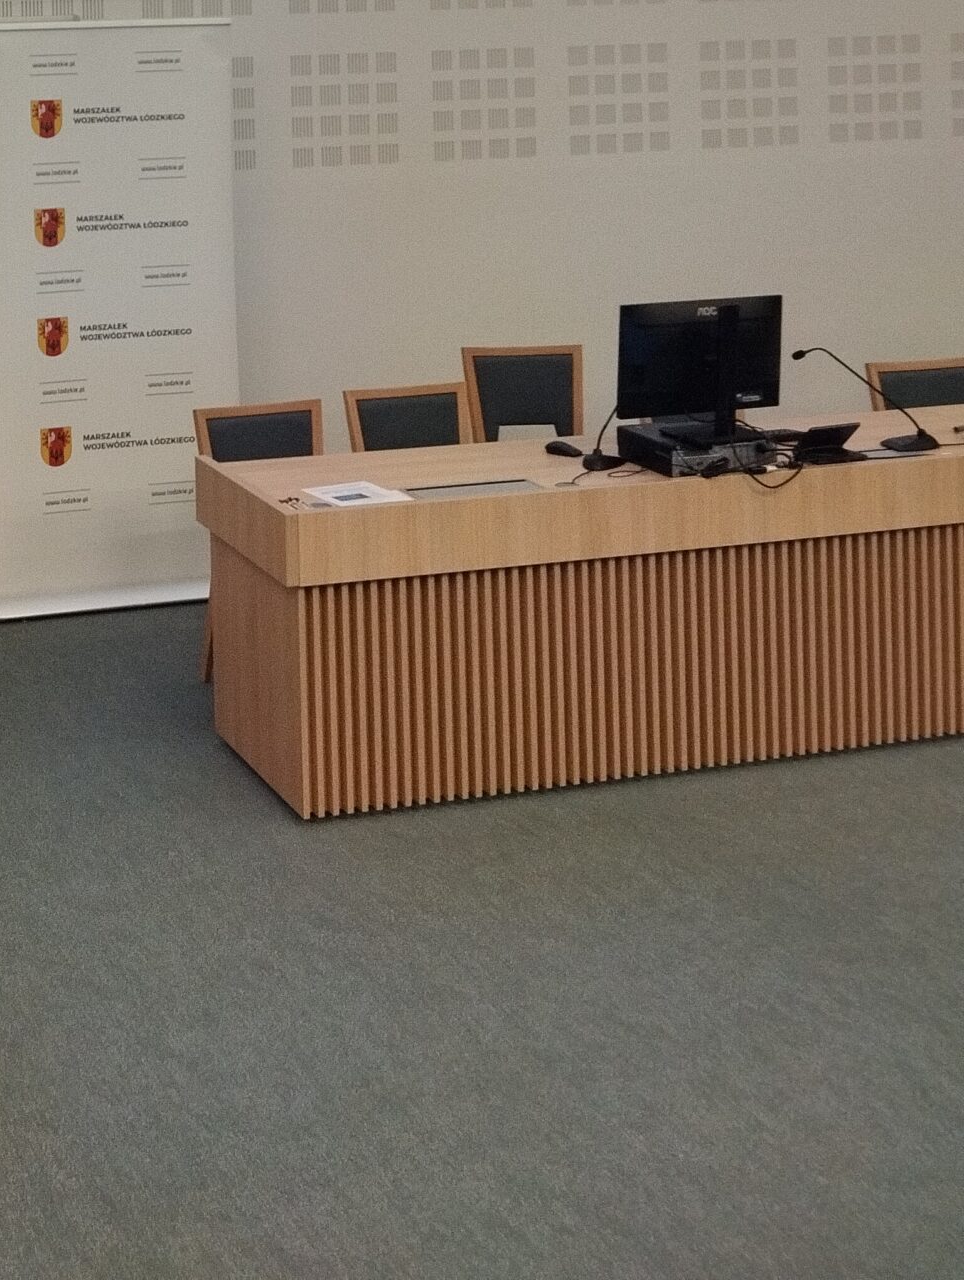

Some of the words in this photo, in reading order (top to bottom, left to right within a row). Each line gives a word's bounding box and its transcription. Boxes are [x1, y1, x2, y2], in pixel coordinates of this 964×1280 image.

[73, 107, 121, 115] MARSZAŁEK
[73, 115, 138, 124] WOJEWÓDZTWA
[140, 113, 186, 122] ŁÓDZKIEGO
[76, 214, 125, 223] MARSZAŁEK
[77, 222, 142, 232] WOJEWÓDZTWA
[143, 220, 189, 229] ŁÓDZKIEGO
[80, 322, 128, 332] MARSZAŁEK
[80, 331, 145, 341] WOJEWÓDZTWA
[146, 328, 193, 337] ŁÓDZKIEGO
[83, 431, 132, 441] MARSZAŁEK
[83, 440, 149, 451] WOJEWÓDZTWA
[150, 436, 196, 446] ŁÓDZKIEGO
